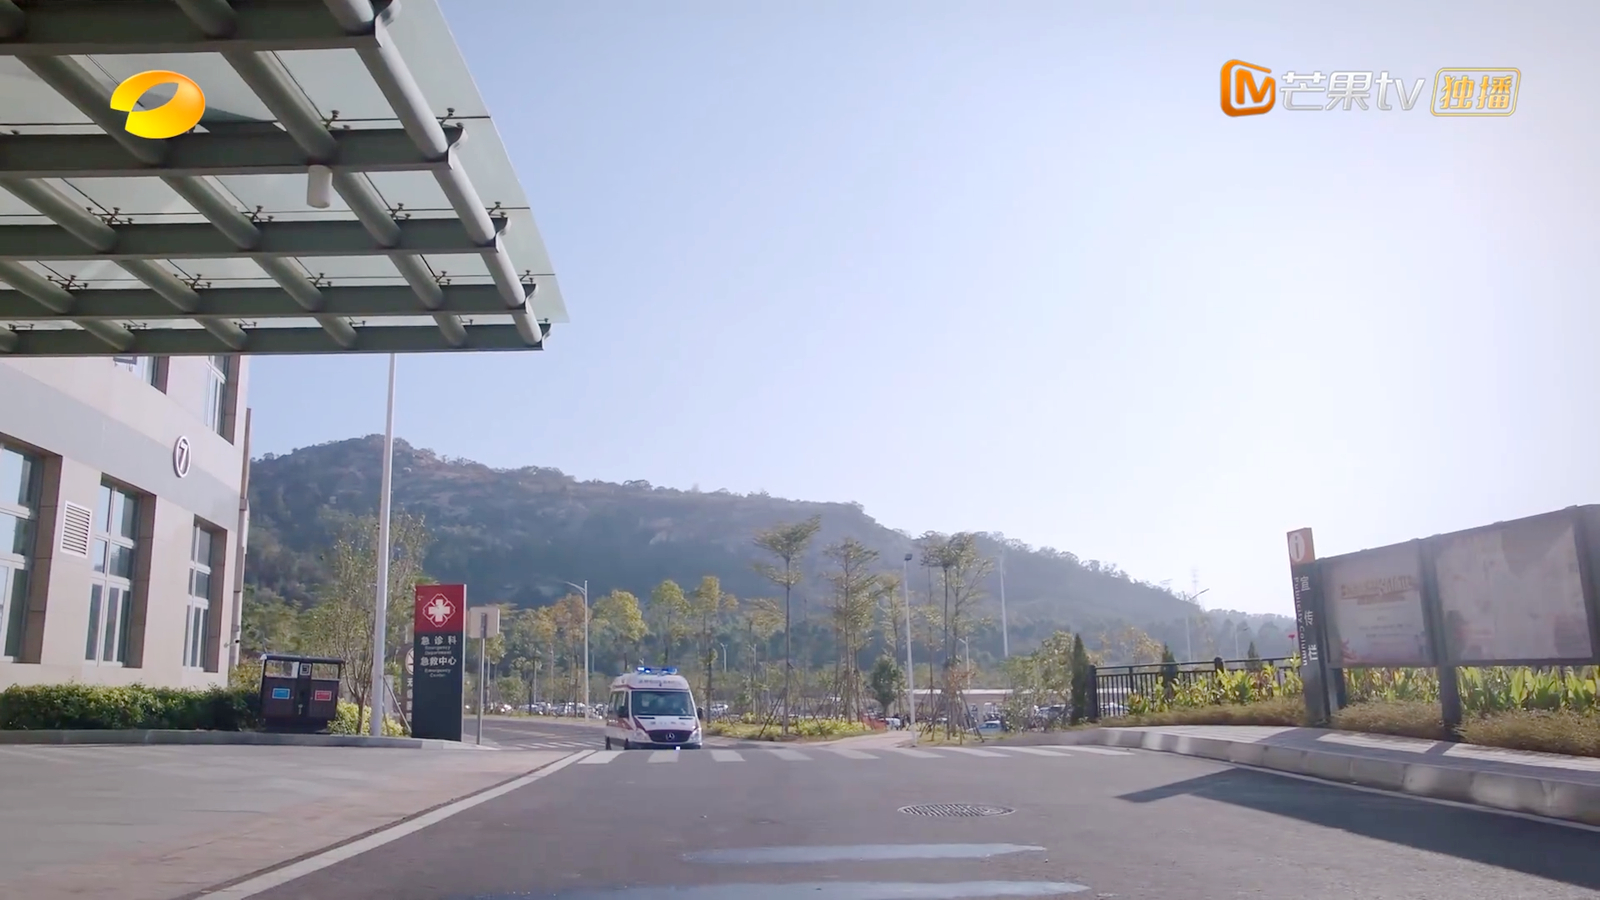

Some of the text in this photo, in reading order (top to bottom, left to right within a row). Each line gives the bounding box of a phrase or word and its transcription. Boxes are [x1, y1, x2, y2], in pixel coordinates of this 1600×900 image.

[1300, 575, 1318, 661] 宣传栏
[420, 635, 457, 645] 急诊科
[420, 656, 457, 666] 急救中心
